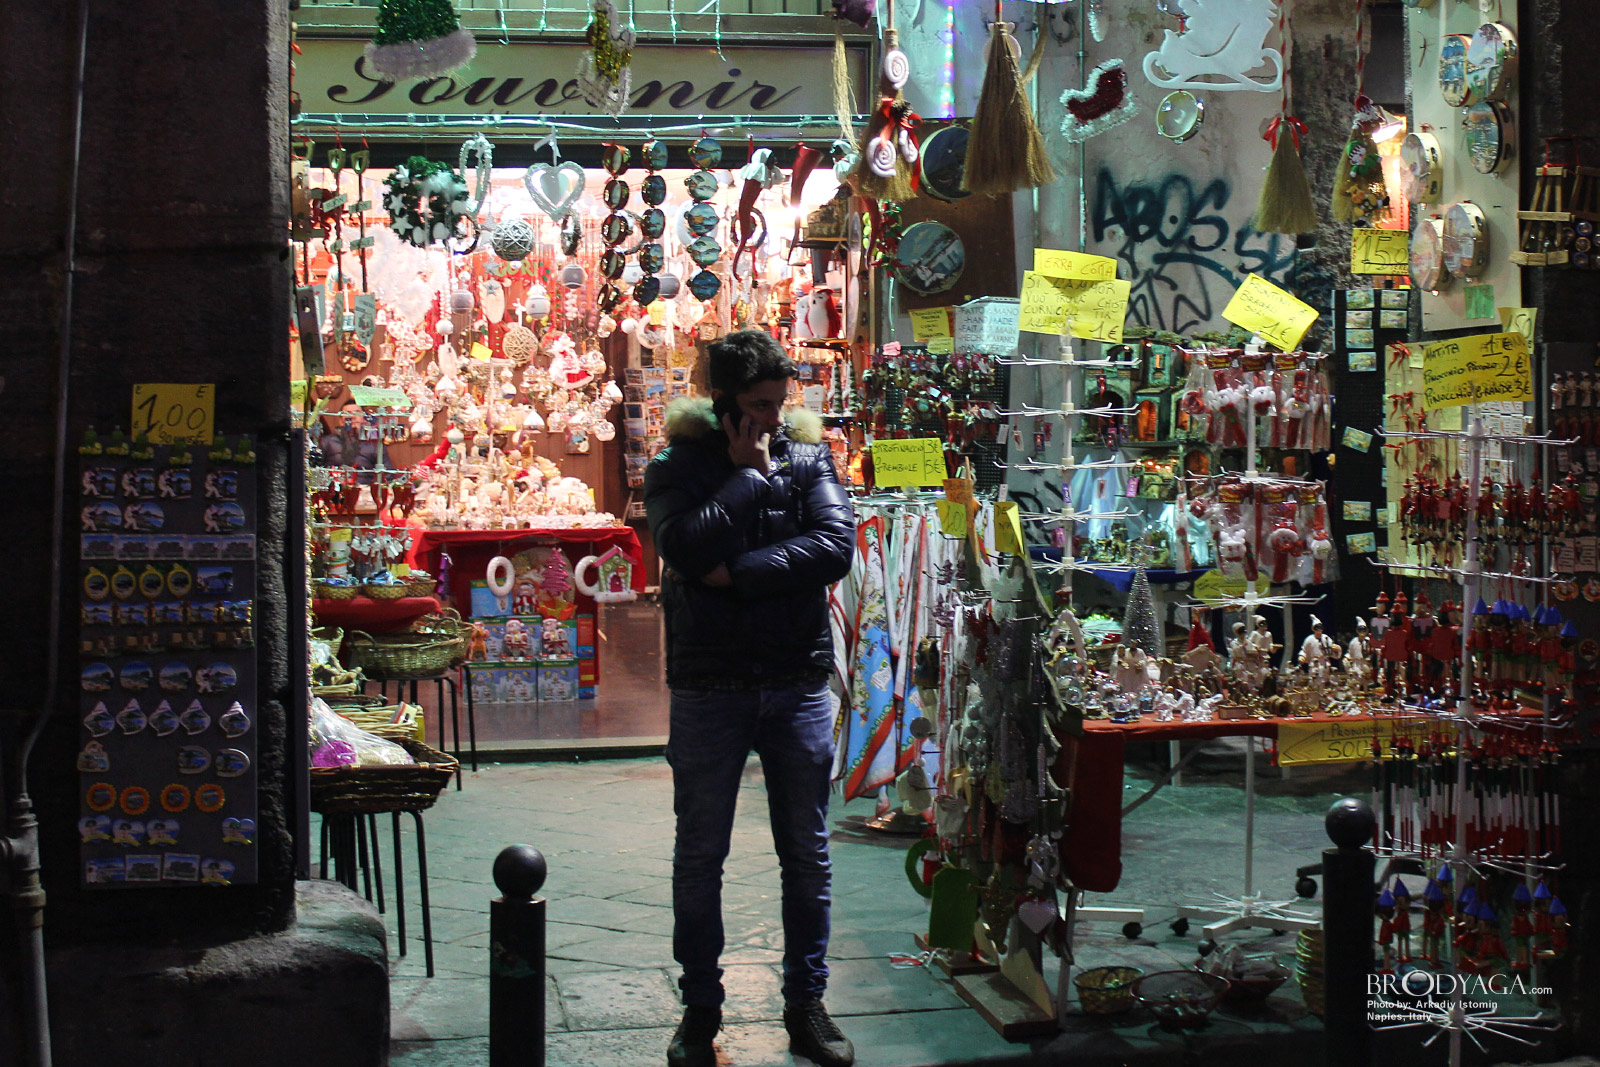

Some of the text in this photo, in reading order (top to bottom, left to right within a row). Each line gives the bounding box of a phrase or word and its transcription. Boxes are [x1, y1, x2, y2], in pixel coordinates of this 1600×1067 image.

[327, 55, 803, 107] Souvnir
[1034, 249, 1113, 277] TERRA COTTA
[1424, 387, 1473, 407] PINOCCHIO
